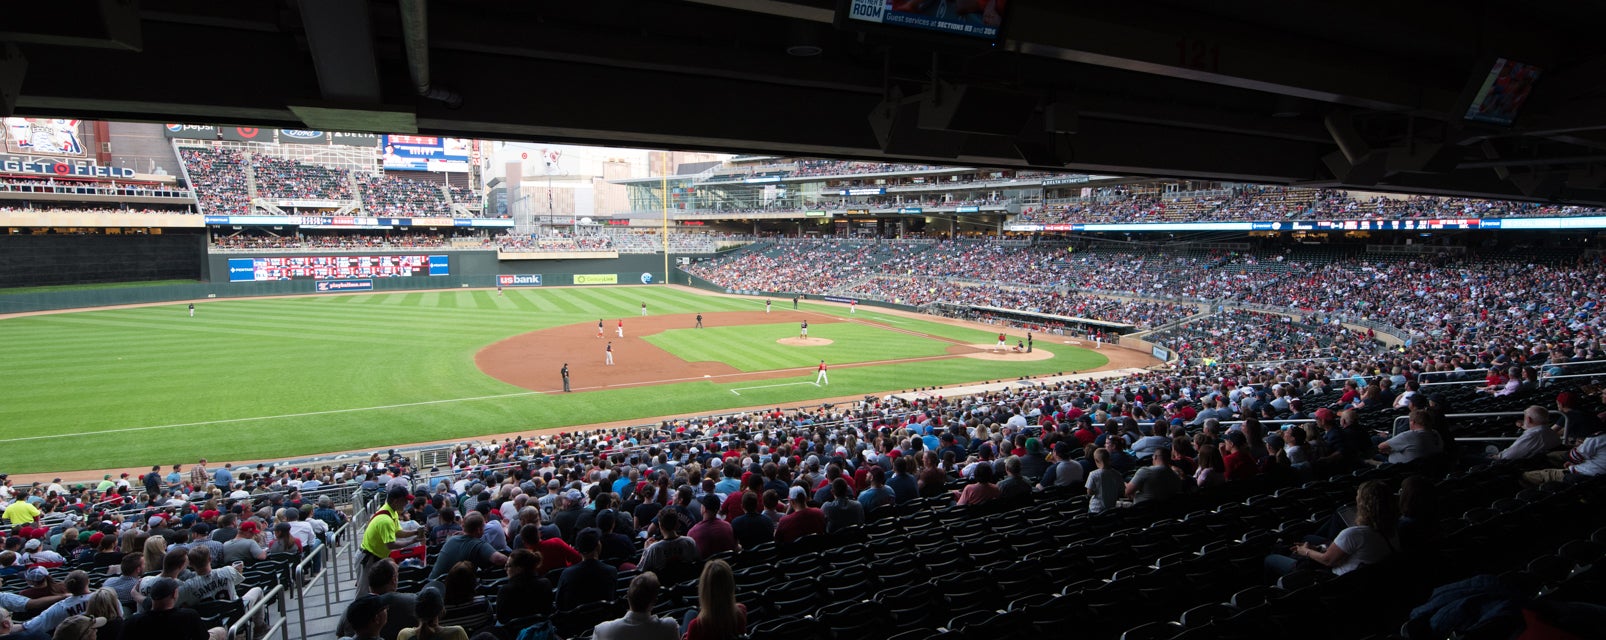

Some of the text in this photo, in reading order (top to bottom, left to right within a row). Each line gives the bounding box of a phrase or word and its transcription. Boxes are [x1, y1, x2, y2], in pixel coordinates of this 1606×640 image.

[853, 3, 882, 18] ROOM
[886, 12, 904, 22] Guest
[905, 15, 929, 26] services
[937, 20, 964, 31] SECTIONS
[972, 26, 984, 34] and
[0, 160, 136, 178] GET FIELD
